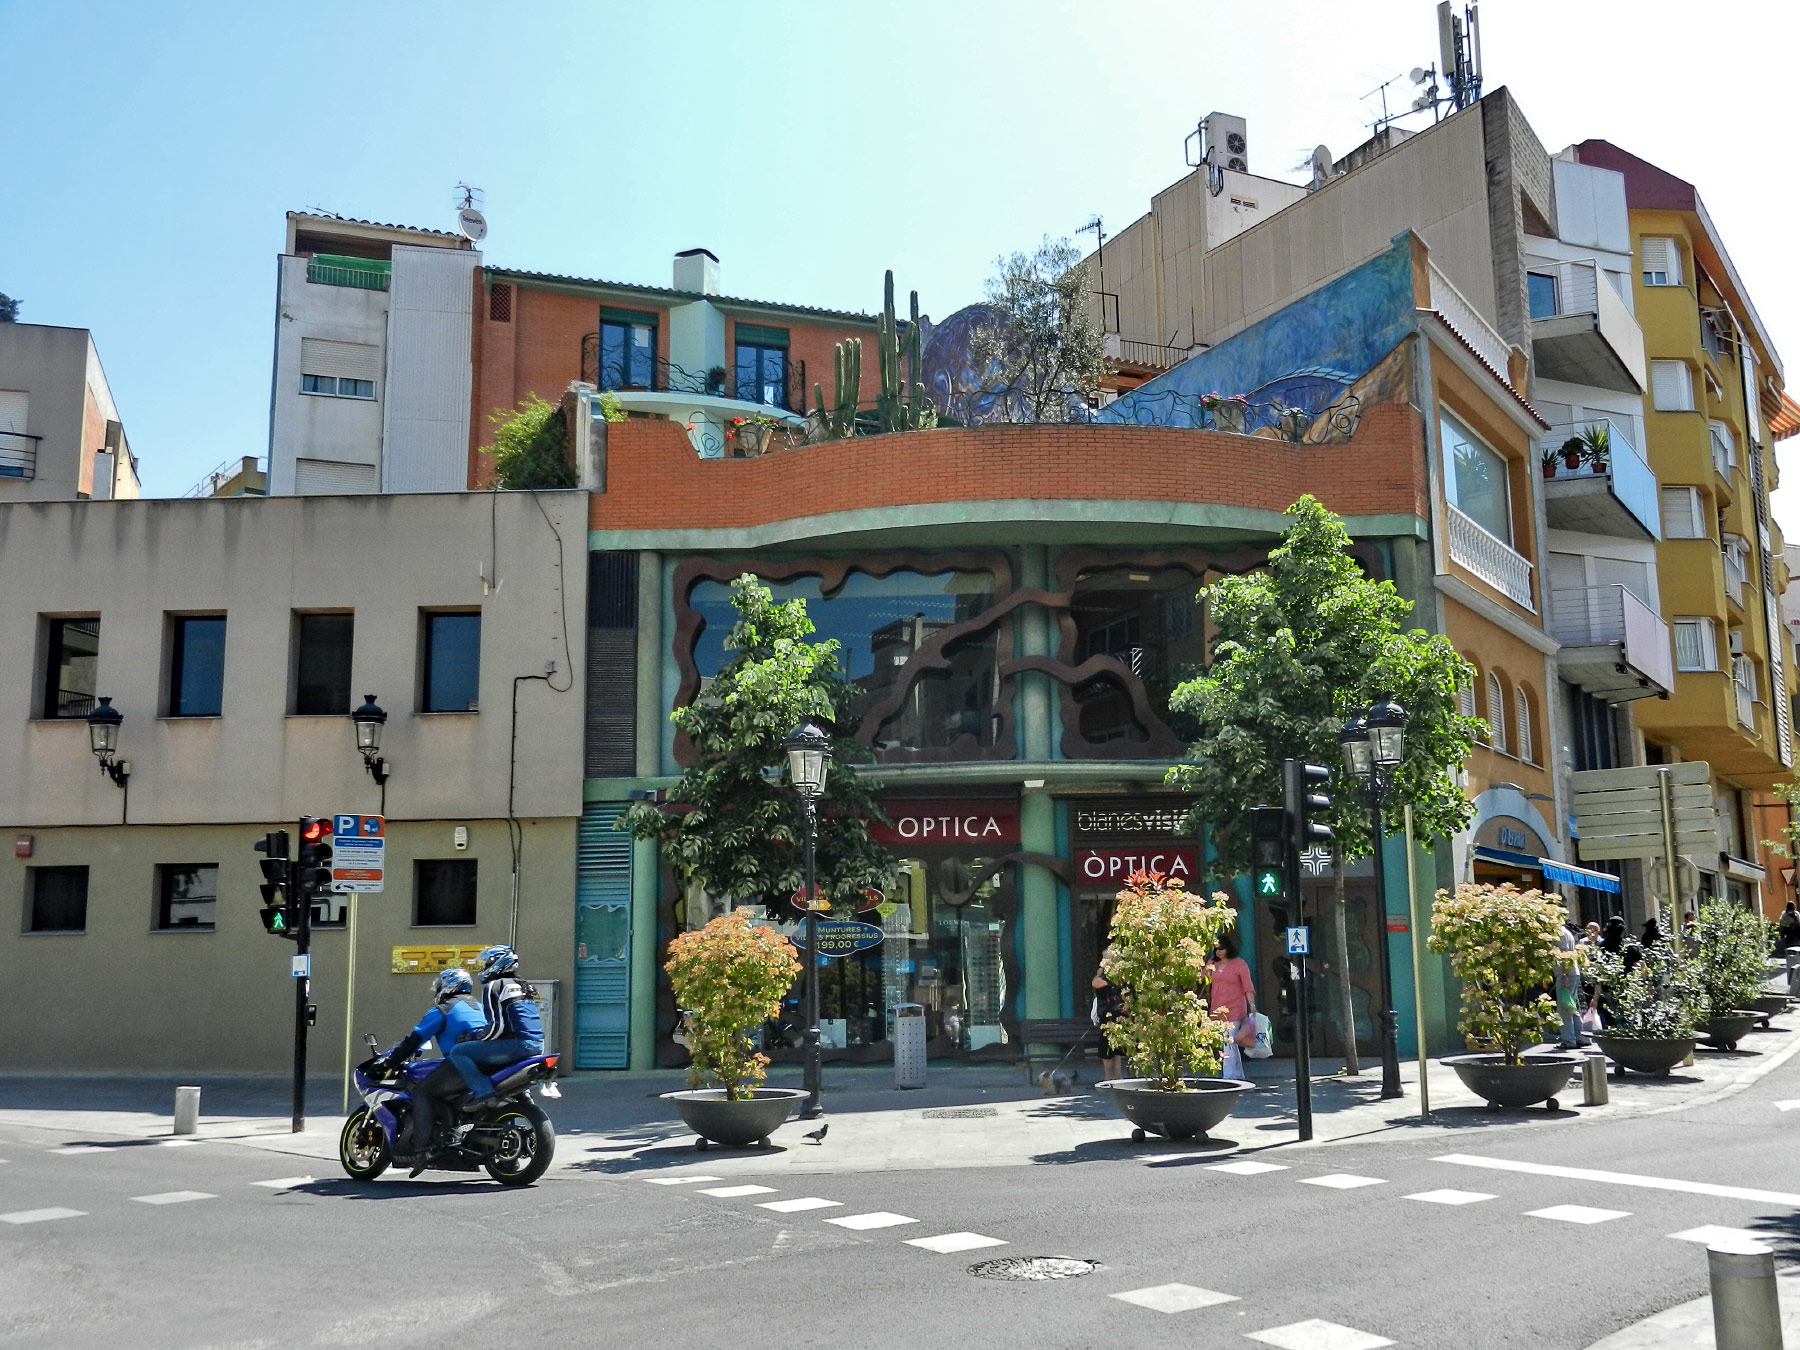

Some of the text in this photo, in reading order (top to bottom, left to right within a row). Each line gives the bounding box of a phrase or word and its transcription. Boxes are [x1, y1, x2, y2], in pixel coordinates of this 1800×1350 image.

[338, 816, 355, 834] P
[898, 816, 1002, 837] OPTICA
[1084, 849, 1189, 878] ÒPTICA
[825, 932, 878, 940] PROGRESSIUS
